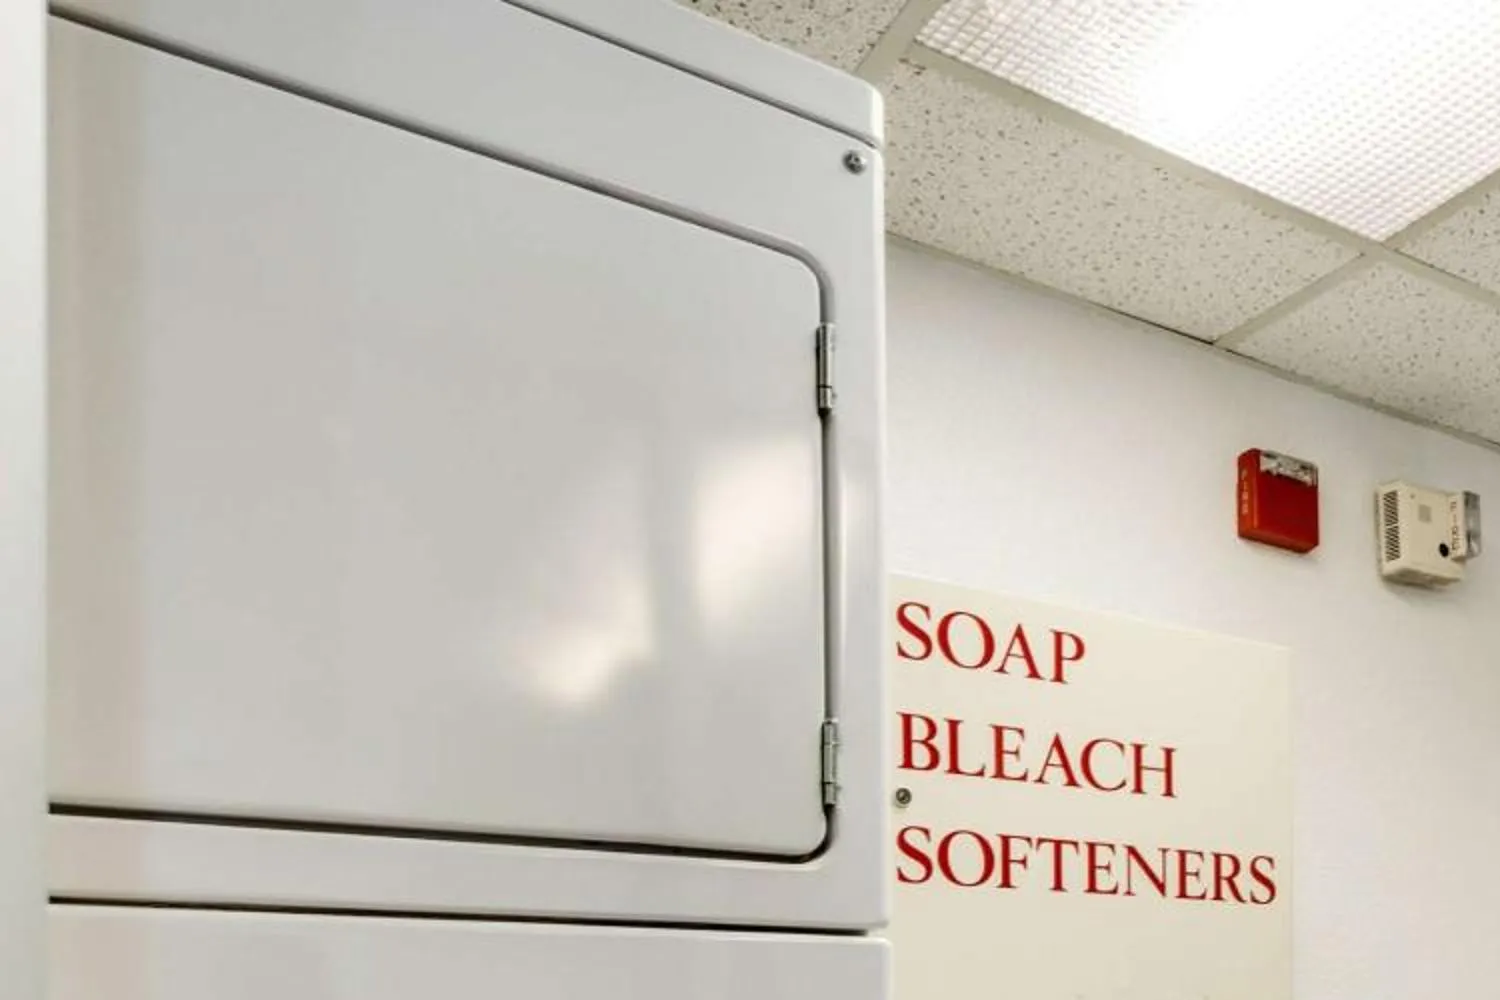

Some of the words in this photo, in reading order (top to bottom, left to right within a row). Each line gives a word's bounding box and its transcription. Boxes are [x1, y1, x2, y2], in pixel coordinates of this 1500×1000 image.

[895, 602, 1086, 684] SOAP
[896, 711, 1178, 798] BLEACH
[896, 825, 1278, 905] SOFTENERS
